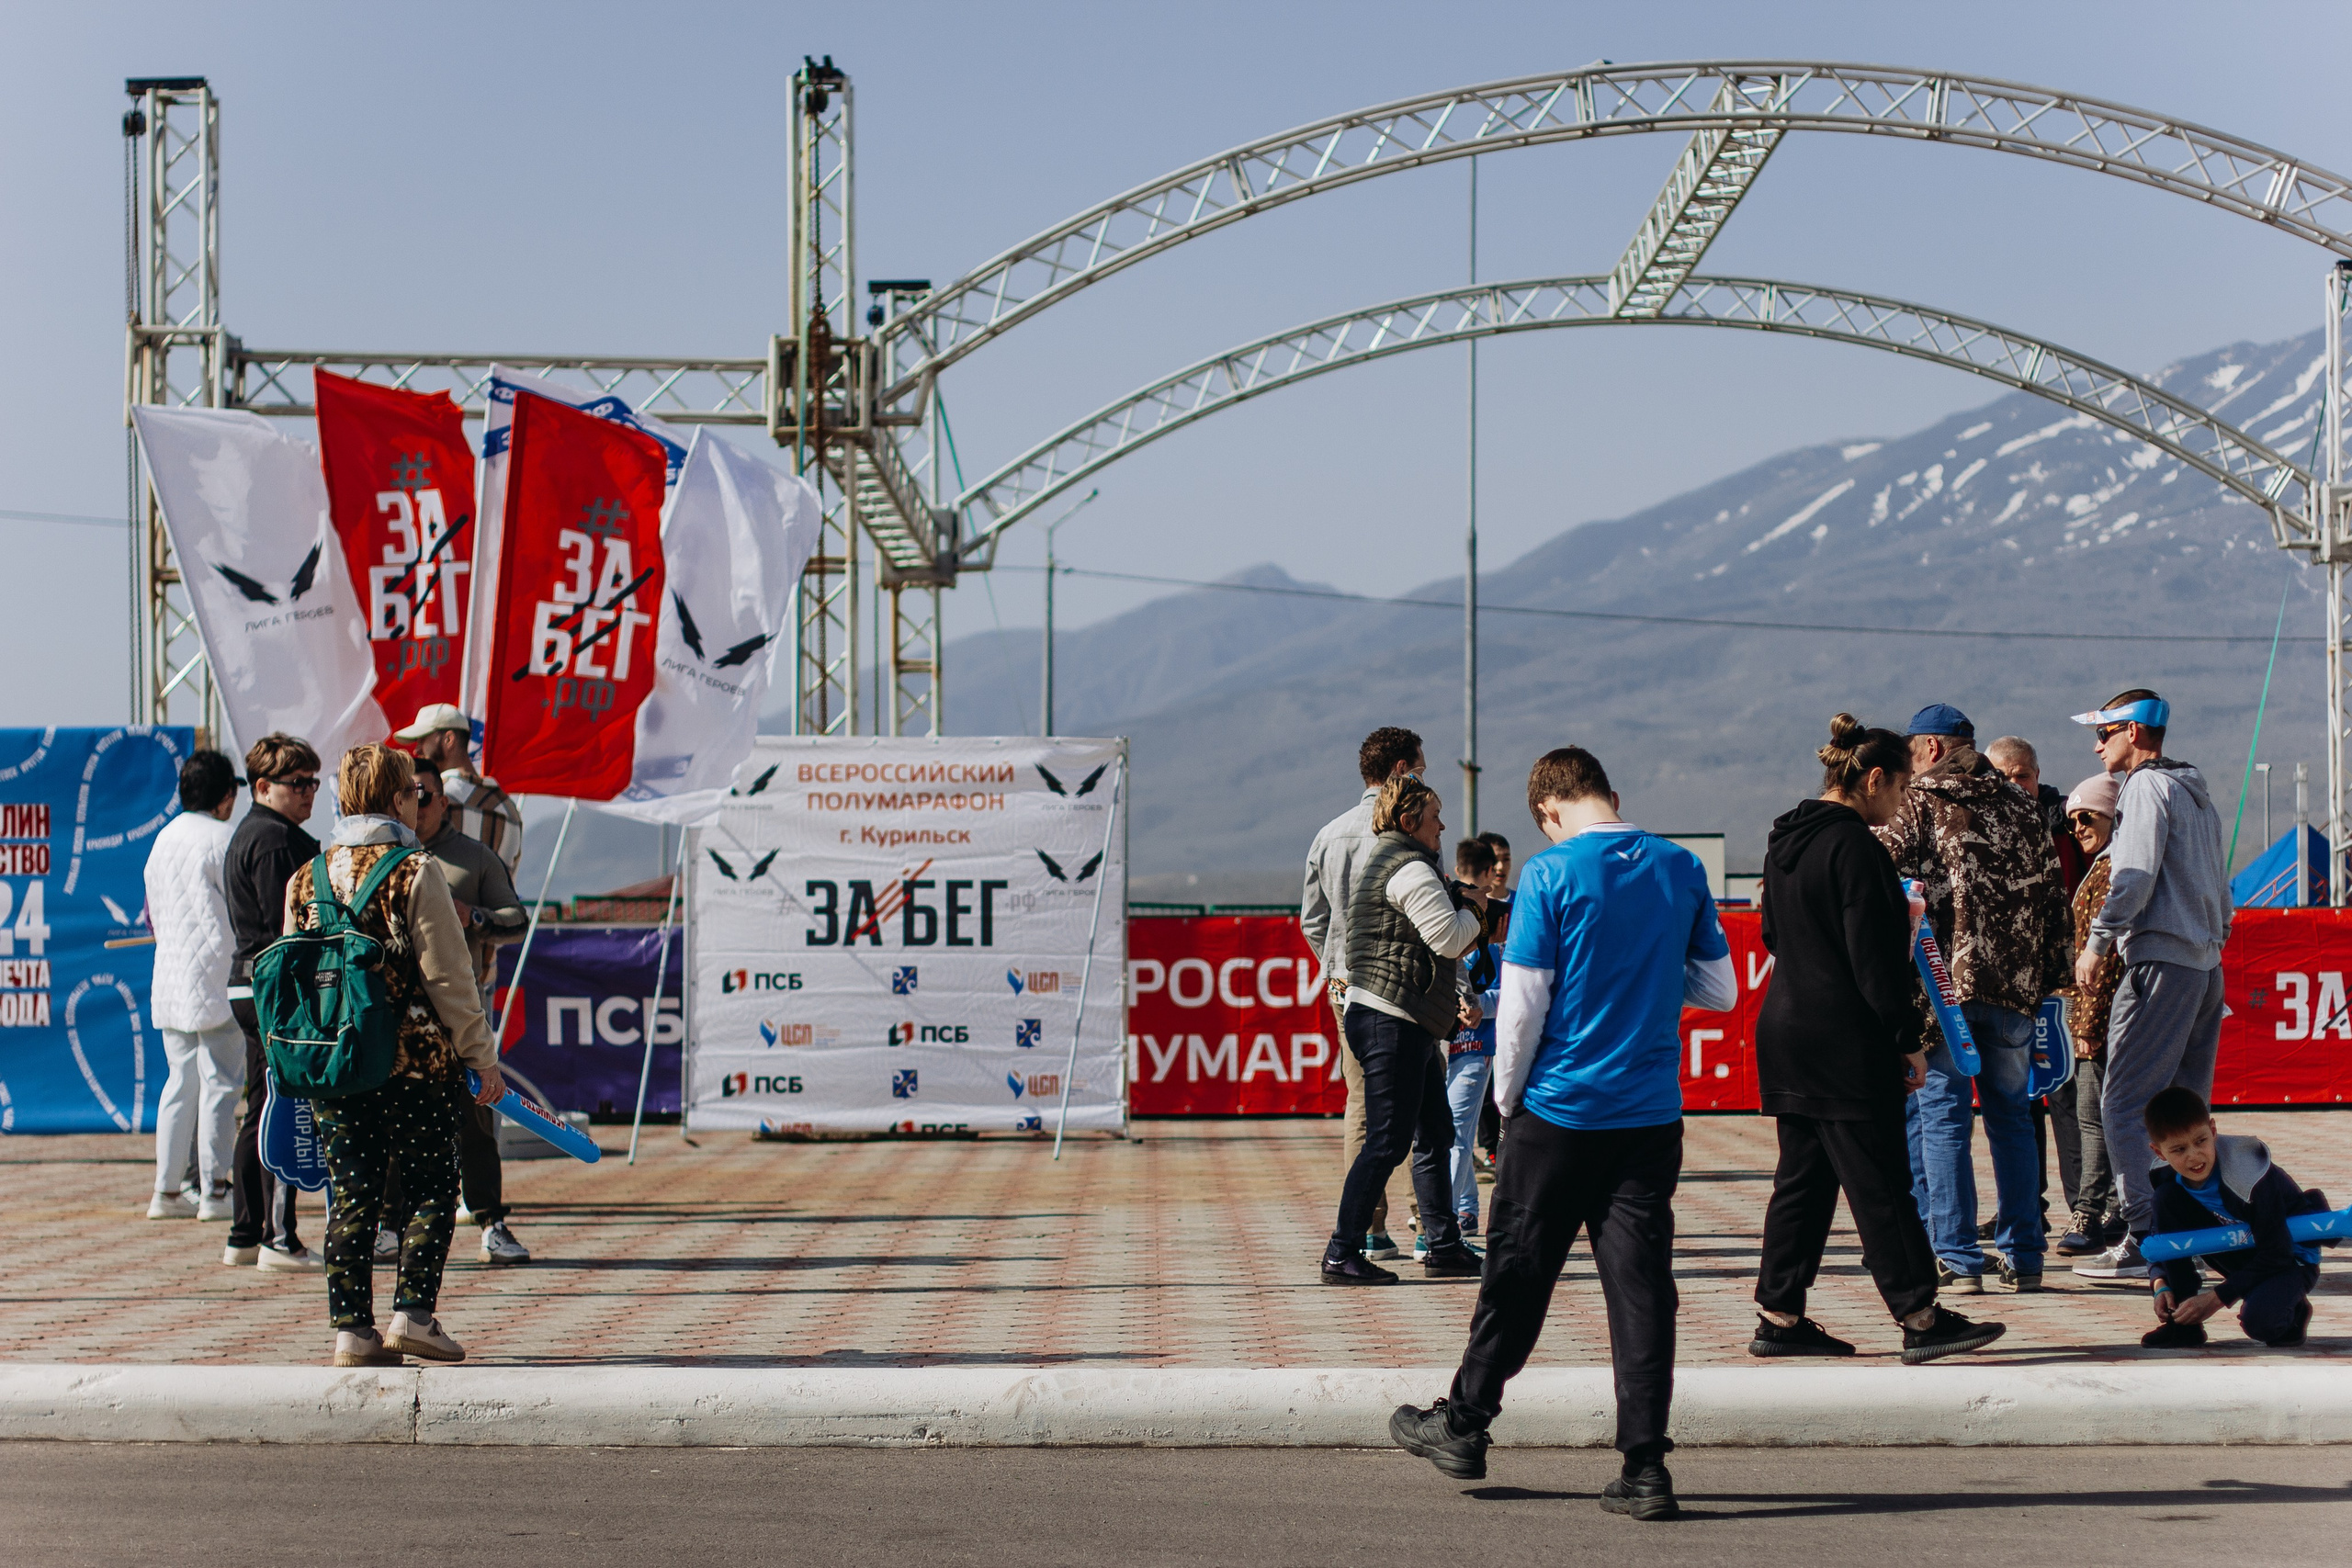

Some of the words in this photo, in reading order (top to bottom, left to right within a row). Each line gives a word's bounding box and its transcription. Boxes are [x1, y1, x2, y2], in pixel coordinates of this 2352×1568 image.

[553, 528, 638, 610] ЗА
[369, 561, 470, 641] БЕГ
[528, 601, 651, 682] БЕГ
[797, 761, 1015, 784] ВСЕРОССИЙСКИЙ
[808, 792, 1005, 812] ПОЛУМАРАФОН
[840, 829, 854, 844] г.
[861, 826, 971, 849] Курильск
[0, 959, 51, 988] ЕЧТА
[755, 973, 803, 990] ПСБ
[0, 993, 51, 1026] ОДА
[547, 995, 683, 1046] ПСБ
[921, 1025, 969, 1043] ПСБ
[1953, 1013, 1970, 1039] ПСБ
[2035, 1016, 2048, 1049] ПСБ
[755, 1076, 803, 1093] ПСБ
[294, 1098, 313, 1169] ЕКОРДЫ!
